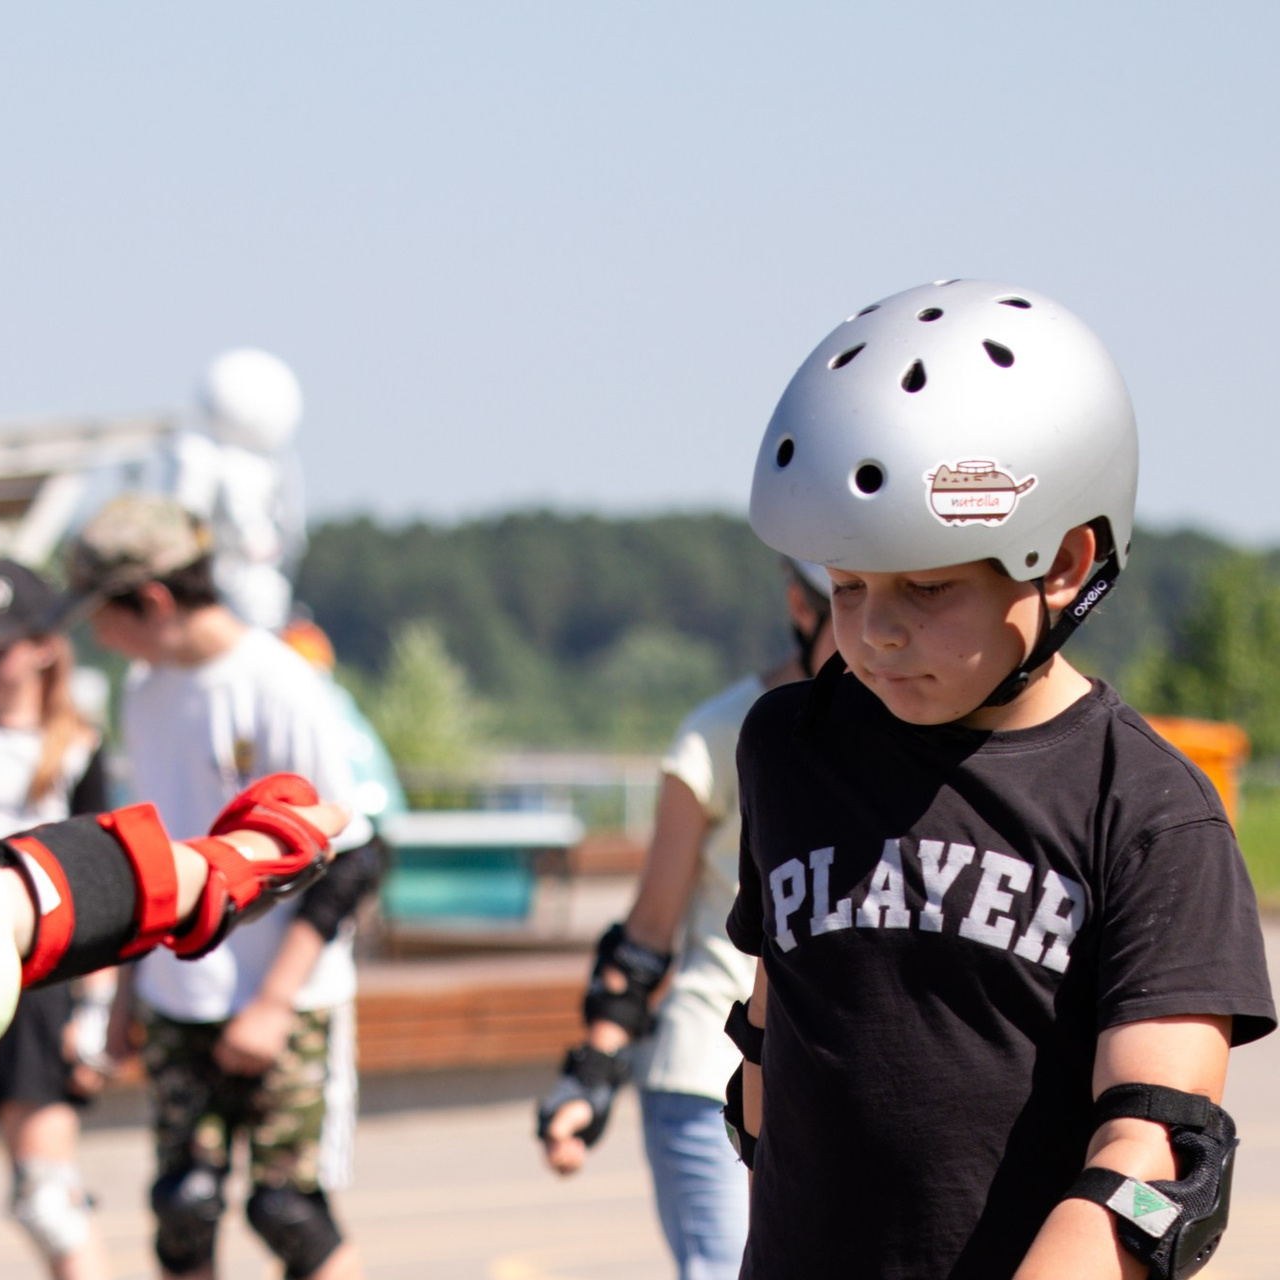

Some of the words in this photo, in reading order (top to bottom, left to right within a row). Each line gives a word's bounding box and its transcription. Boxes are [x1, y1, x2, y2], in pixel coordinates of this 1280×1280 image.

[951, 494, 1000, 508] nutella
[1074, 580, 1108, 617] oxelo
[769, 838, 1086, 975] PLAYER
